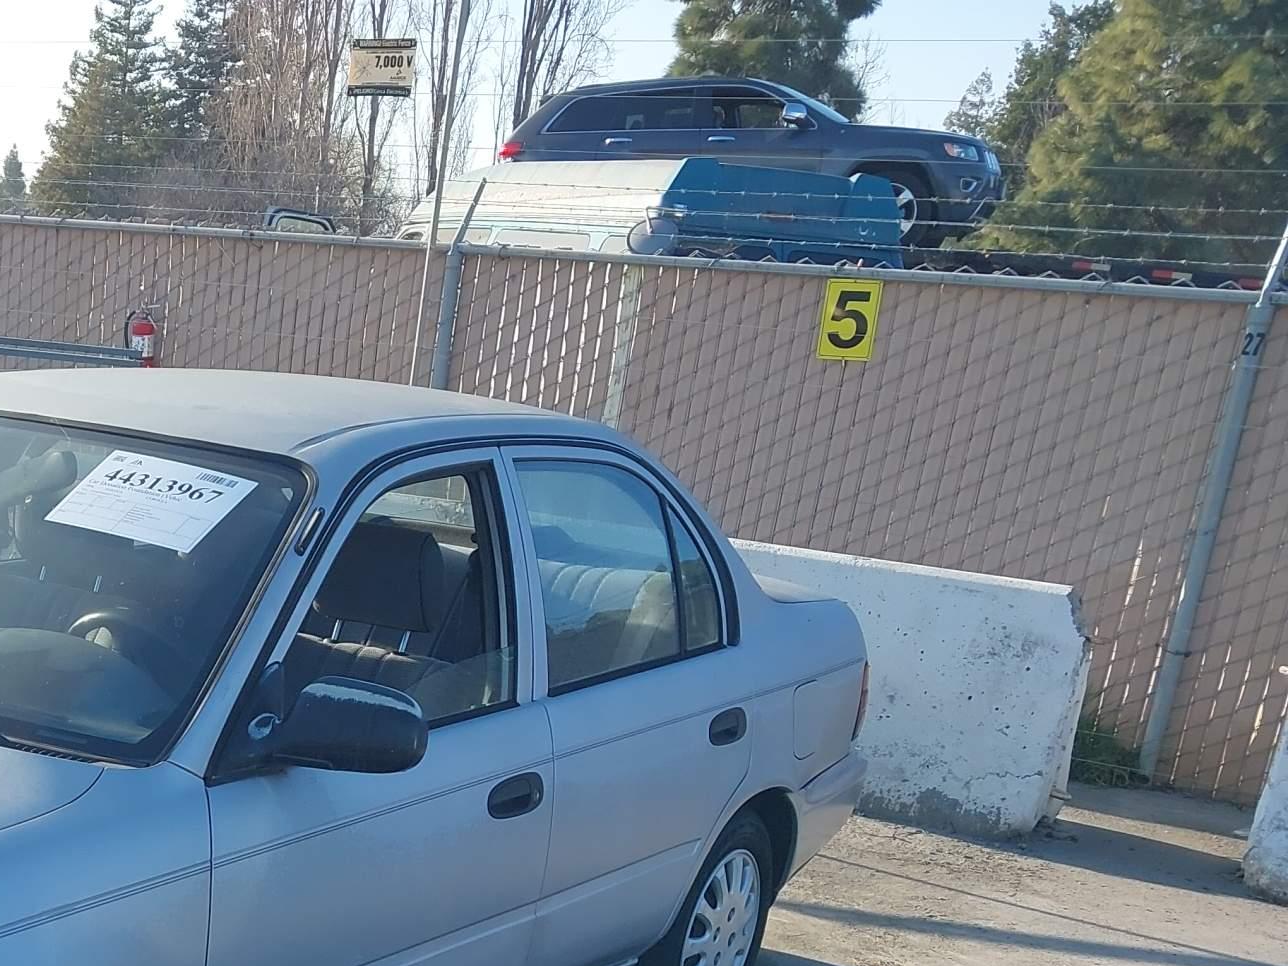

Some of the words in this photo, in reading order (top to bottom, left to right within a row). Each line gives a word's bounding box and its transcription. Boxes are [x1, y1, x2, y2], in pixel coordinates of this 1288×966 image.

[375, 55, 404, 69] 7,000
[407, 55, 414, 68] V
[827, 290, 872, 349] 5
[1241, 332, 1267, 357] 27
[104, 468, 225, 504] 44313967
